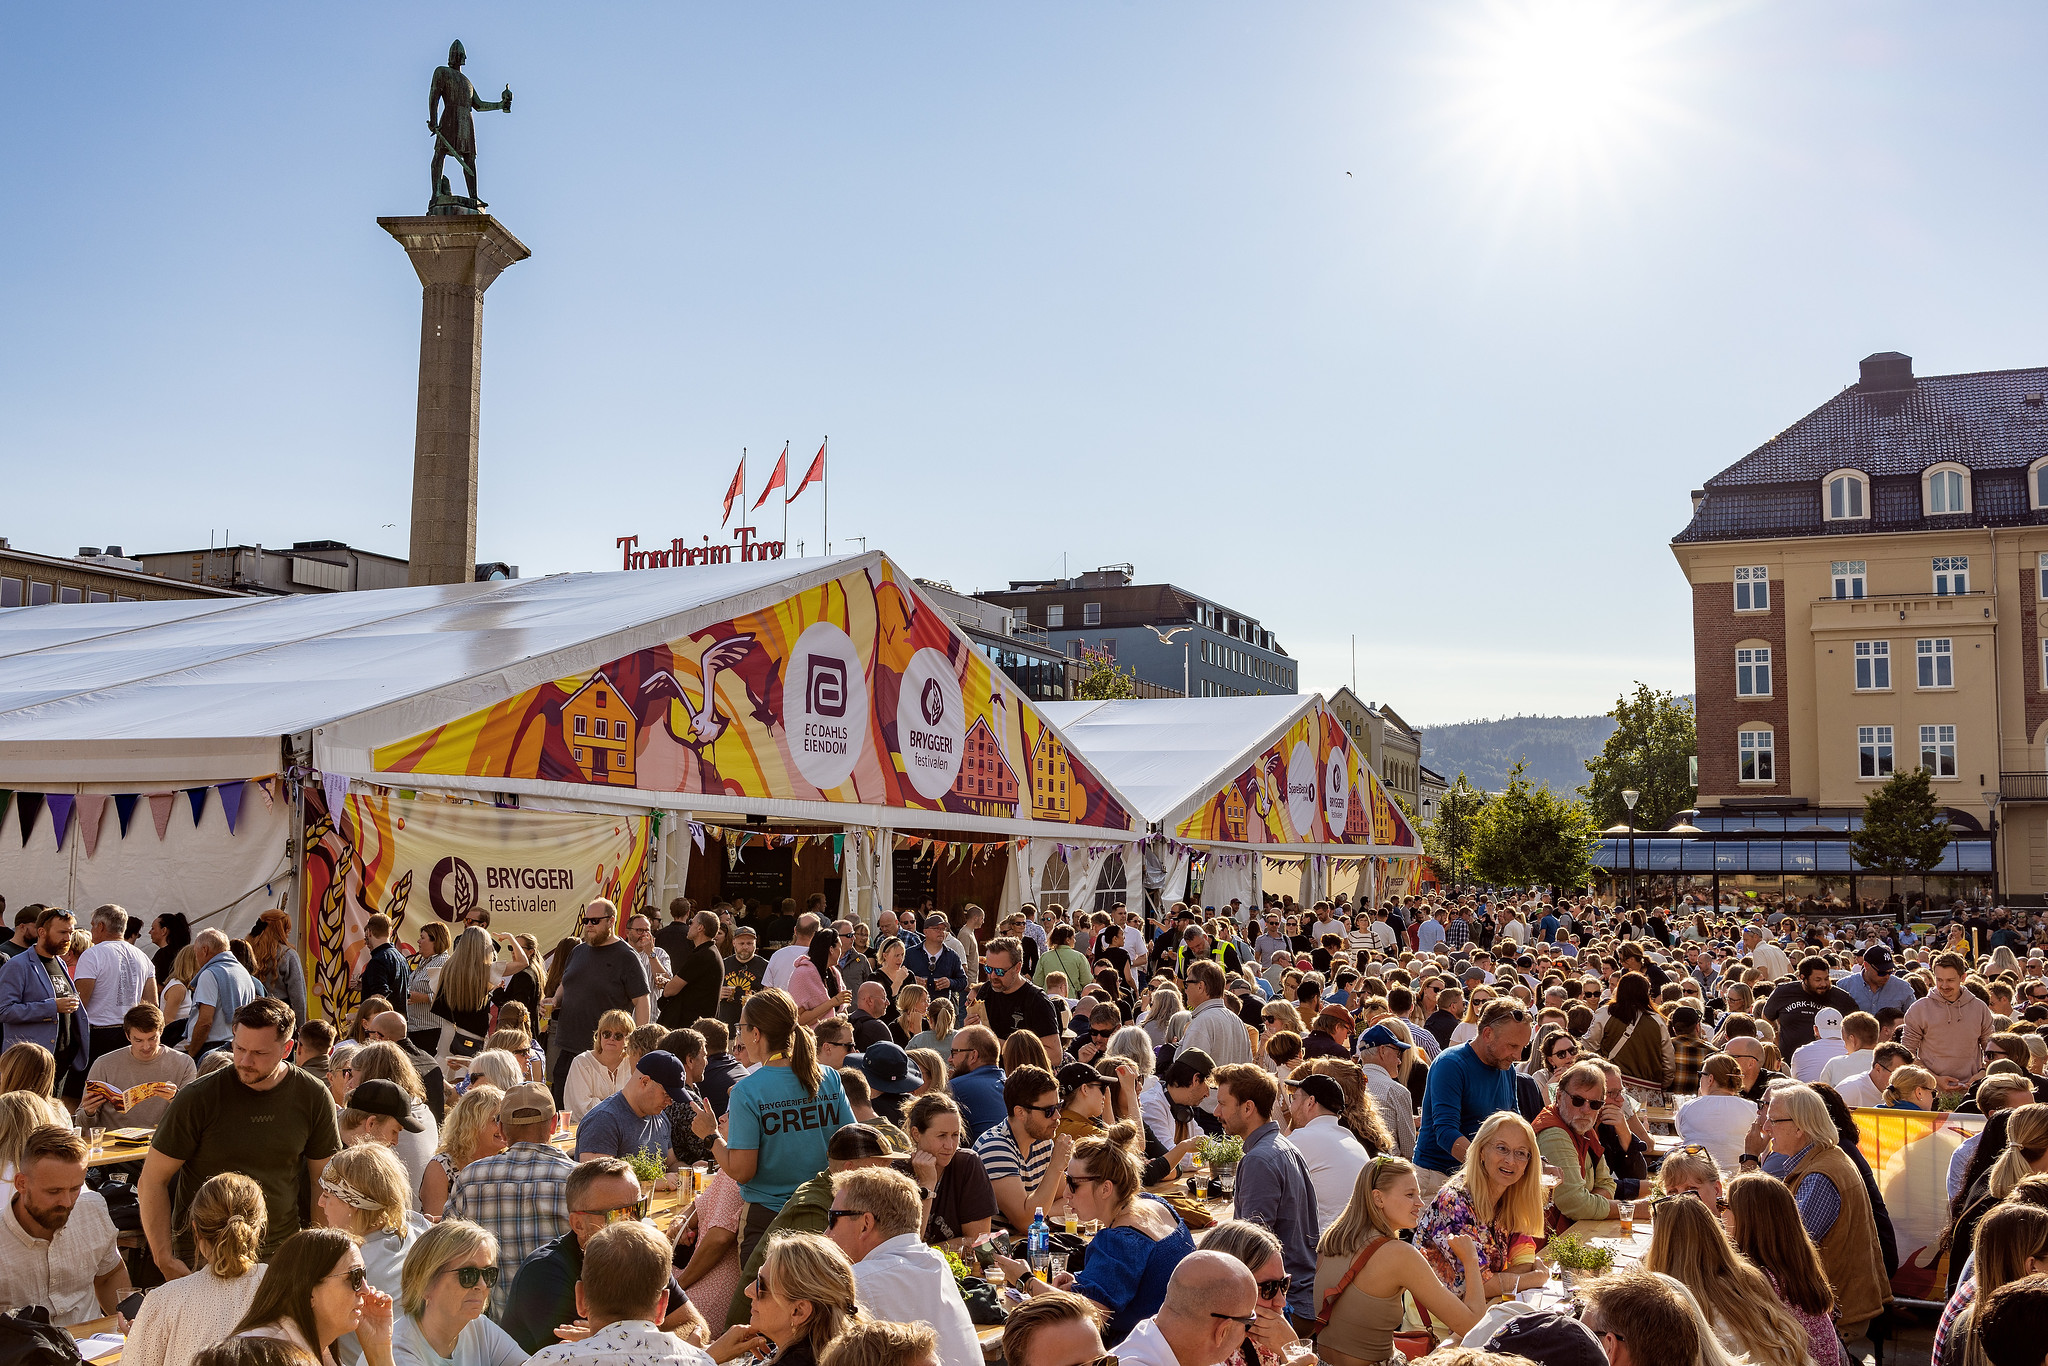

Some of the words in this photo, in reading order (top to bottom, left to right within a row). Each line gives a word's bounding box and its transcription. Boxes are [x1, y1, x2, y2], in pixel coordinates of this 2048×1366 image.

[616, 534, 731, 571] Trondheim
[733, 526, 785, 562] Torg
[818, 725, 847, 739] DAHLS
[910, 730, 953, 754] BRYGGERI
[804, 739, 847, 754] EIENDOM
[915, 752, 949, 771] festivalen
[486, 867, 574, 890] BRYGGERI
[488, 894, 556, 912] festivalen
[762, 1103, 840, 1136] CREW
